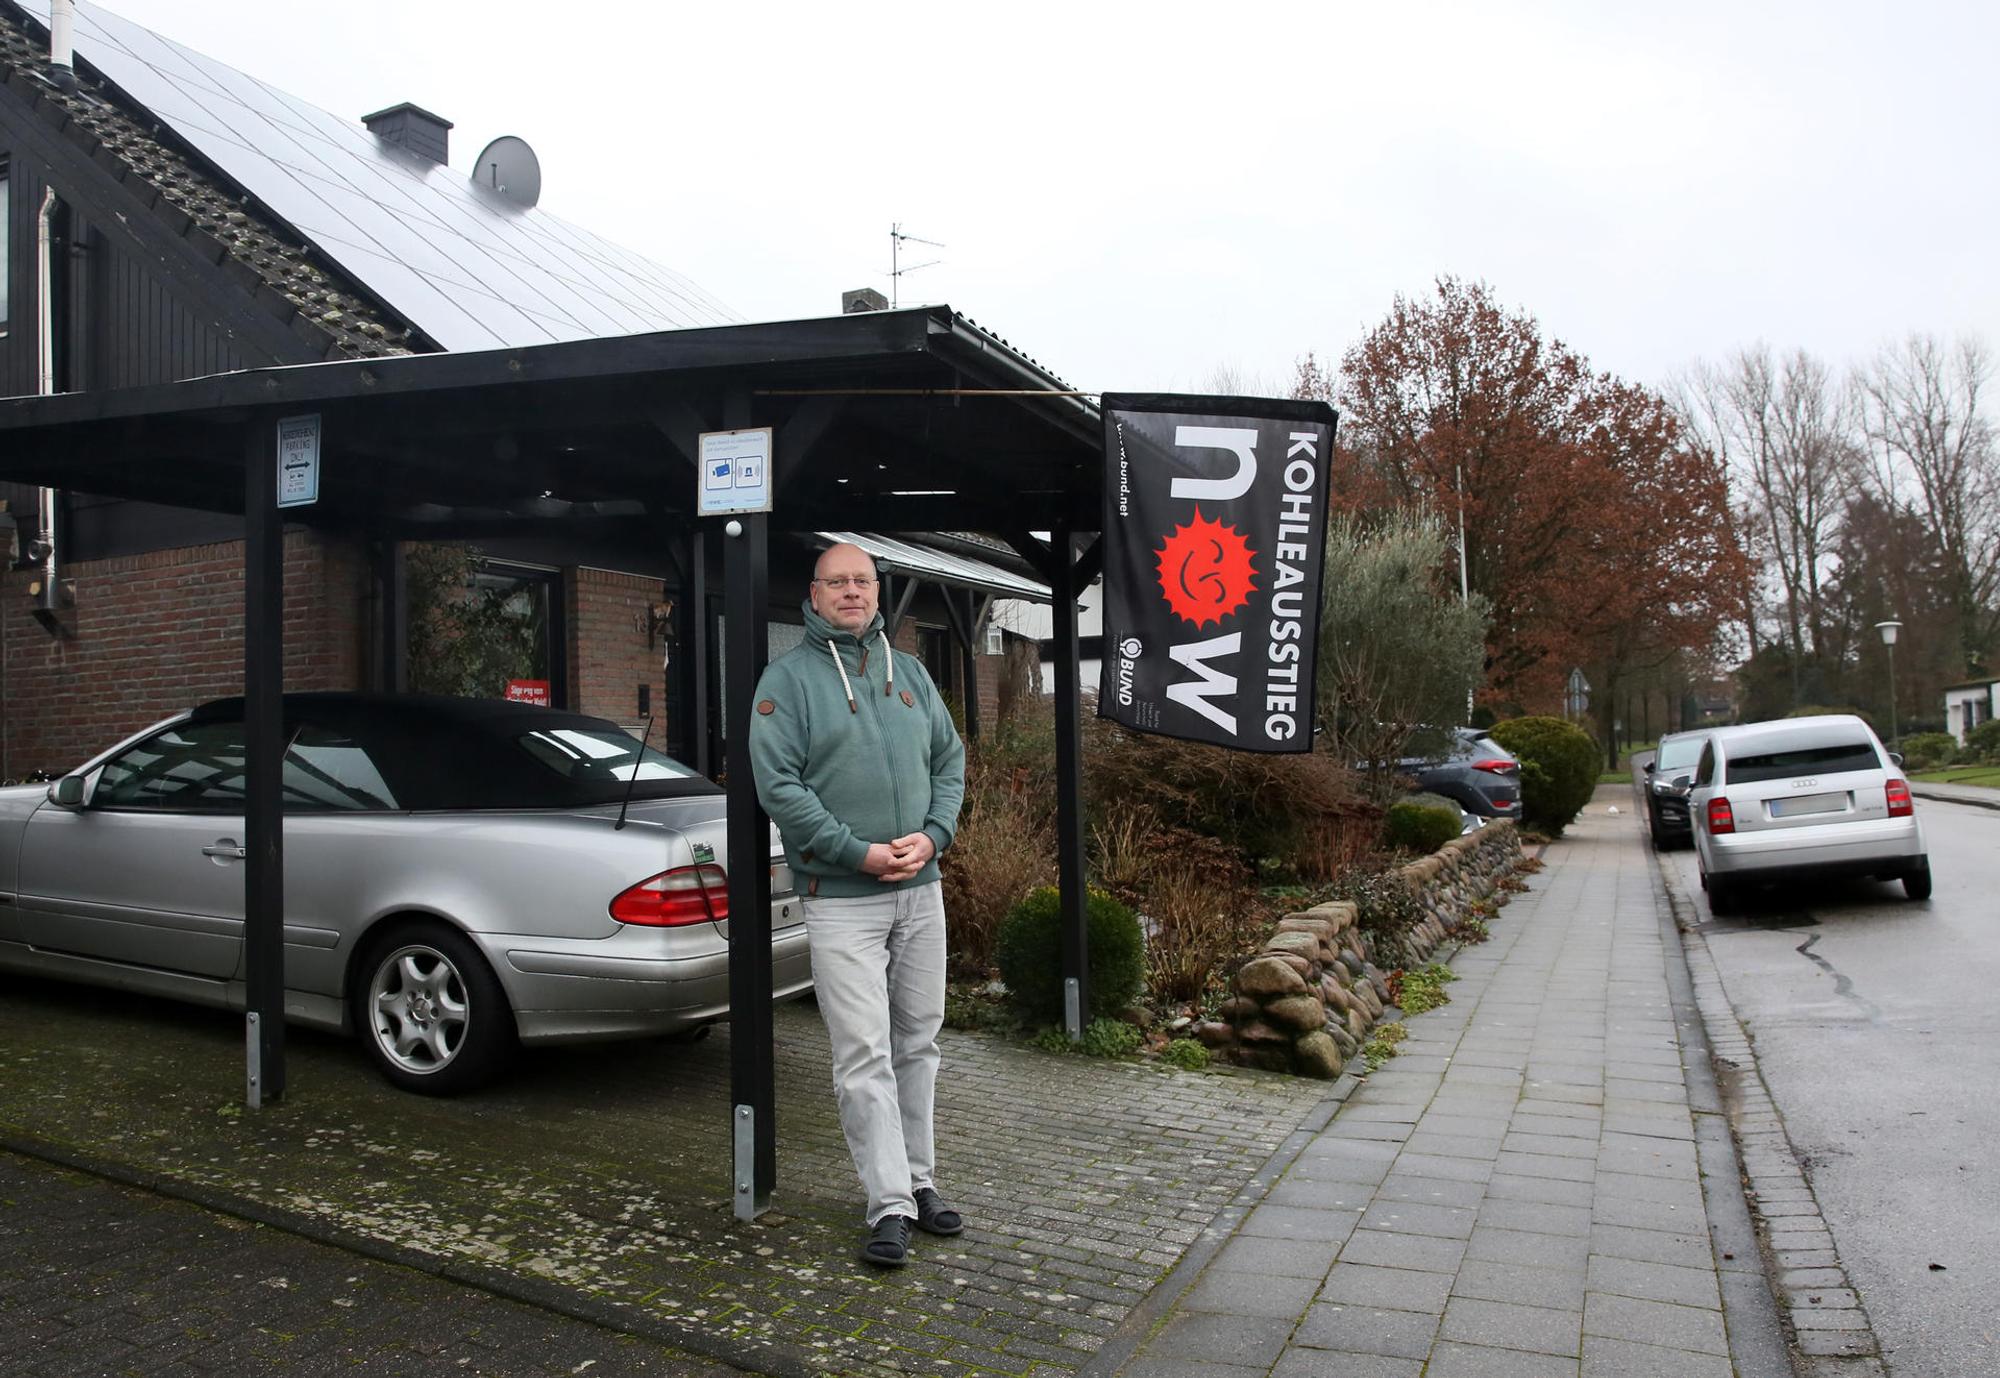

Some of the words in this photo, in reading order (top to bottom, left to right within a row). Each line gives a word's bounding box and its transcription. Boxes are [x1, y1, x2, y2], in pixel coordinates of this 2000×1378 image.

[1116, 423, 1131, 518] w.bund.net
[1264, 431, 1319, 741] KOHLEAUSSTIEG
[1119, 658, 1135, 706] BUND
